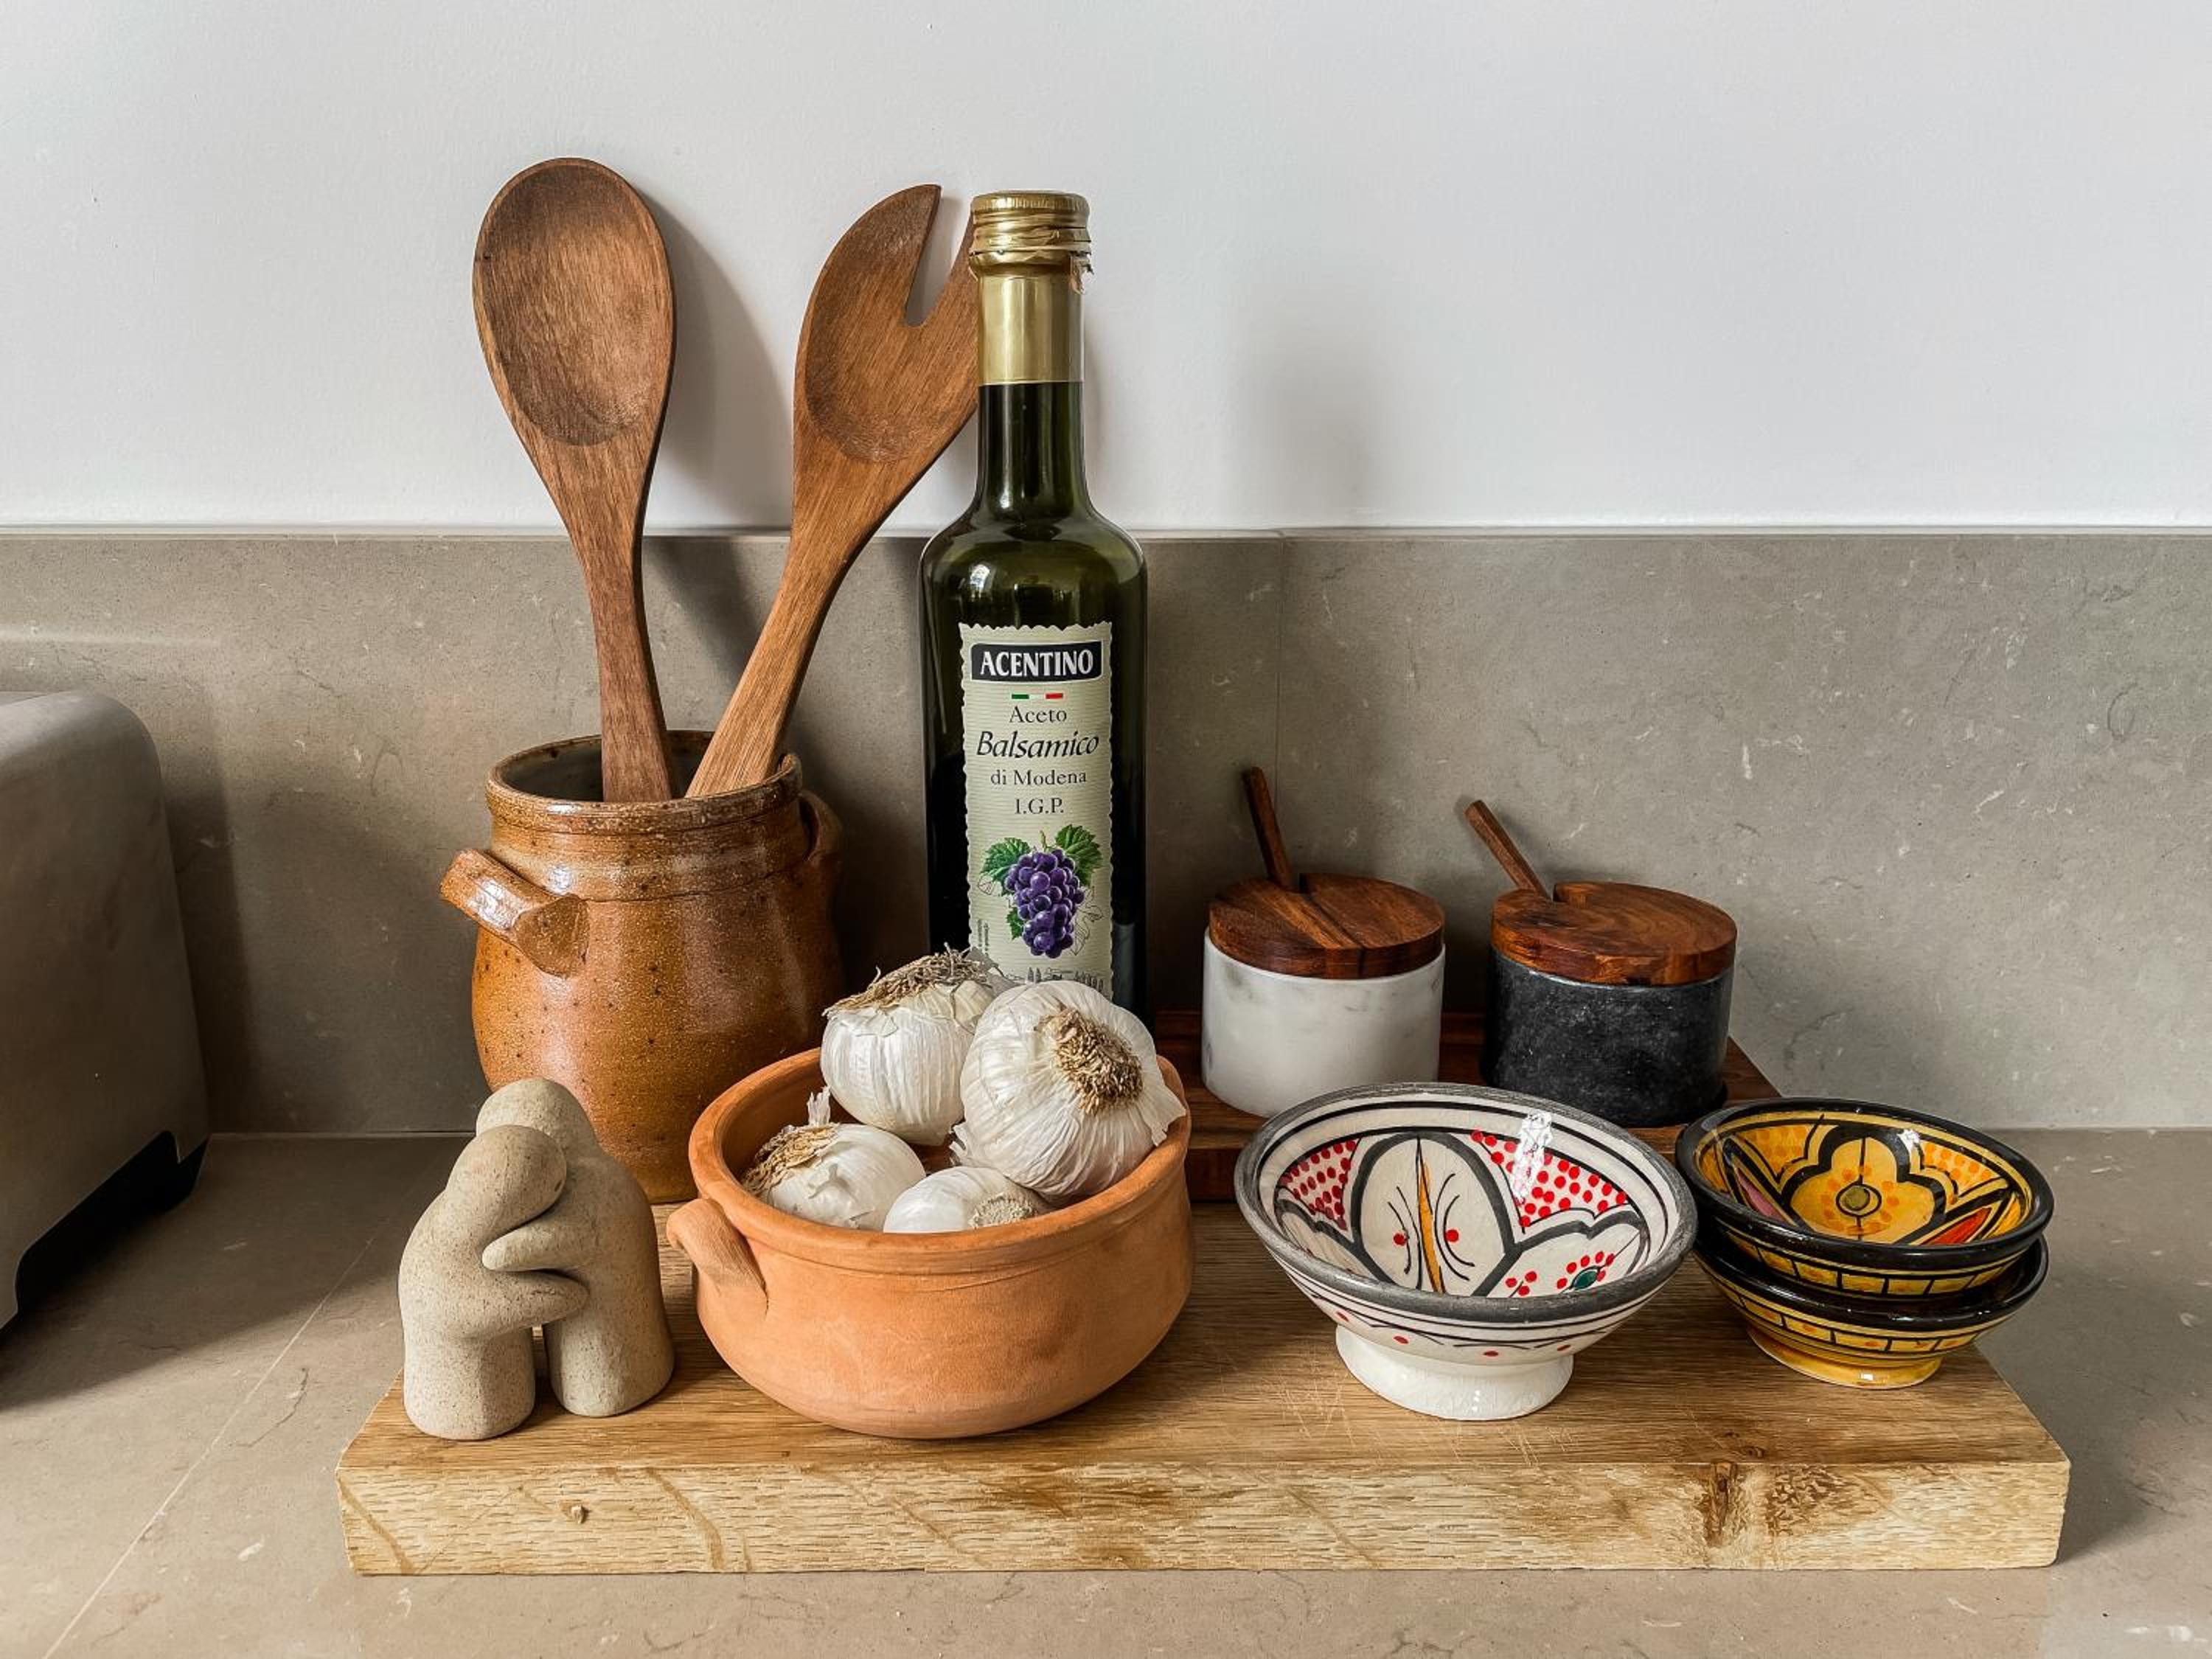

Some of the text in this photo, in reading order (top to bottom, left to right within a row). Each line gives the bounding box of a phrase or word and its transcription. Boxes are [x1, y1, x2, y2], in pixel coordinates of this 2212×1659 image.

[980, 649, 1094, 677] ACENTINO
[1009, 706, 1067, 723] Aceto
[977, 730, 1099, 759] Balsamico
[990, 770, 1087, 786] di Modena
[1015, 797, 1065, 814] I.G.P.
